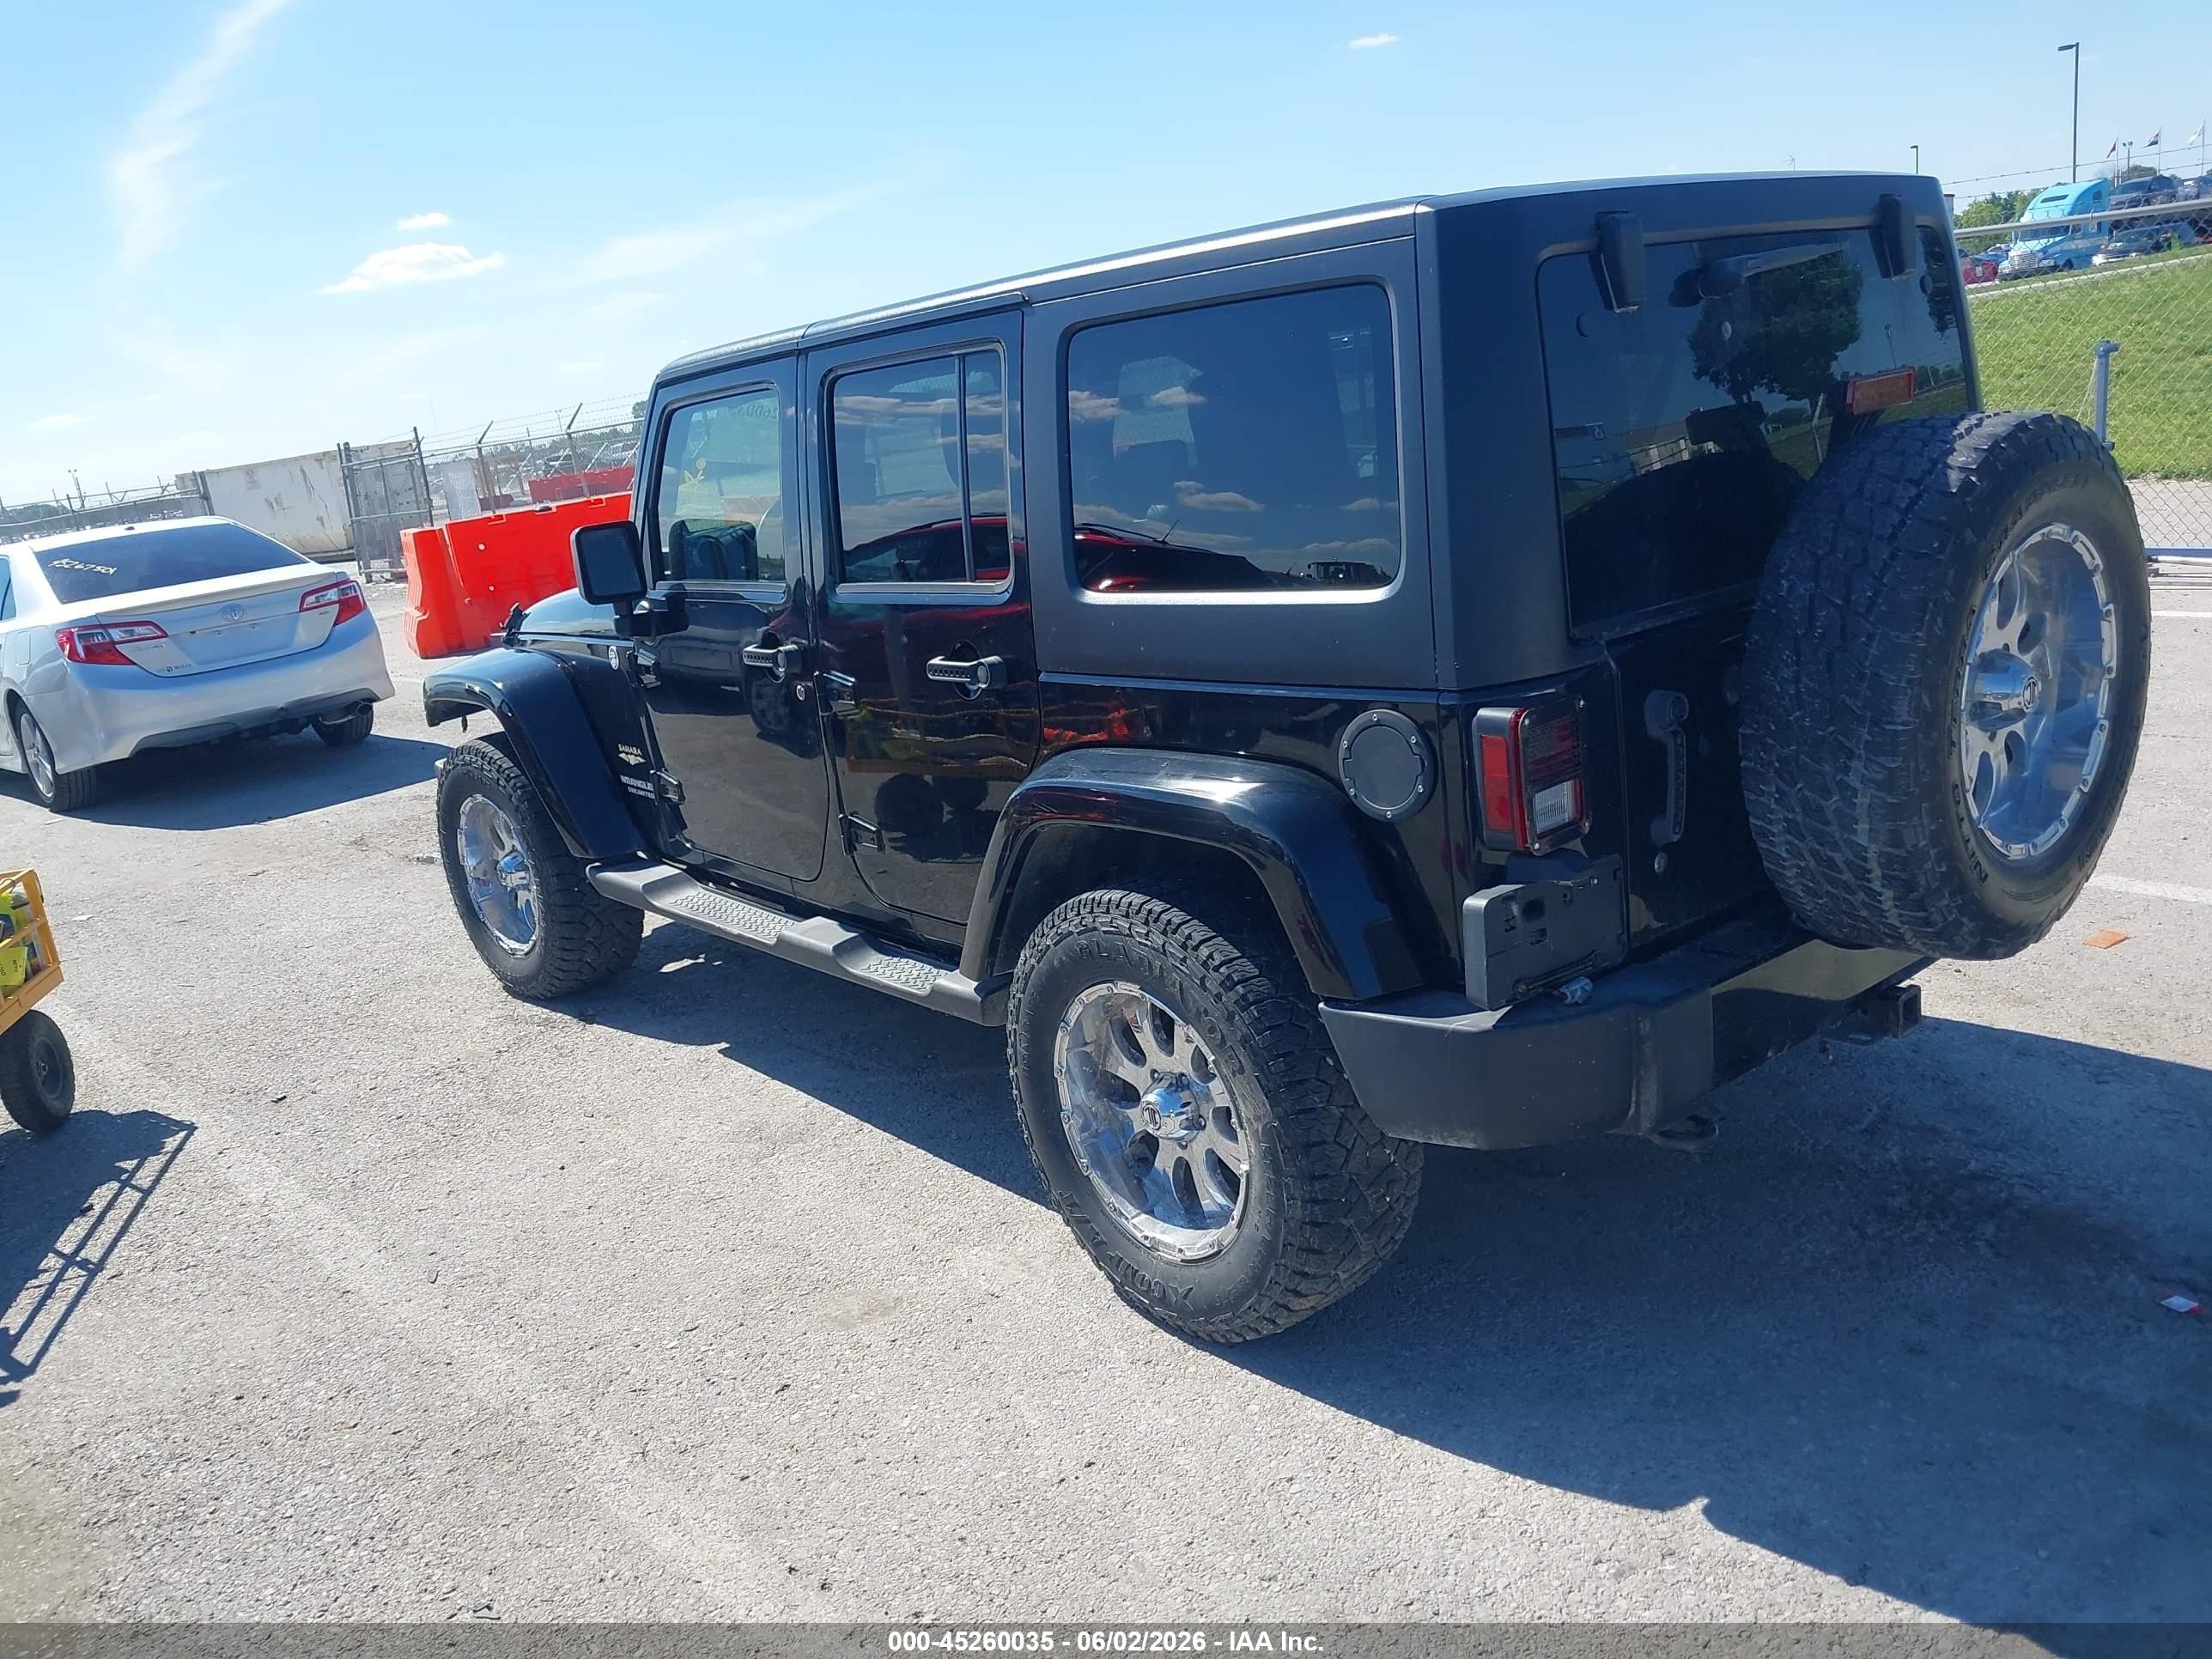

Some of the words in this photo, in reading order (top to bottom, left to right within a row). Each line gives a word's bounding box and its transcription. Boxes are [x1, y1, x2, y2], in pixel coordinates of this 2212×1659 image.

[618, 744, 643, 756] SAHARA
[620, 775, 653, 791] WRANGLE
[1950, 781, 1990, 885] NITTO
